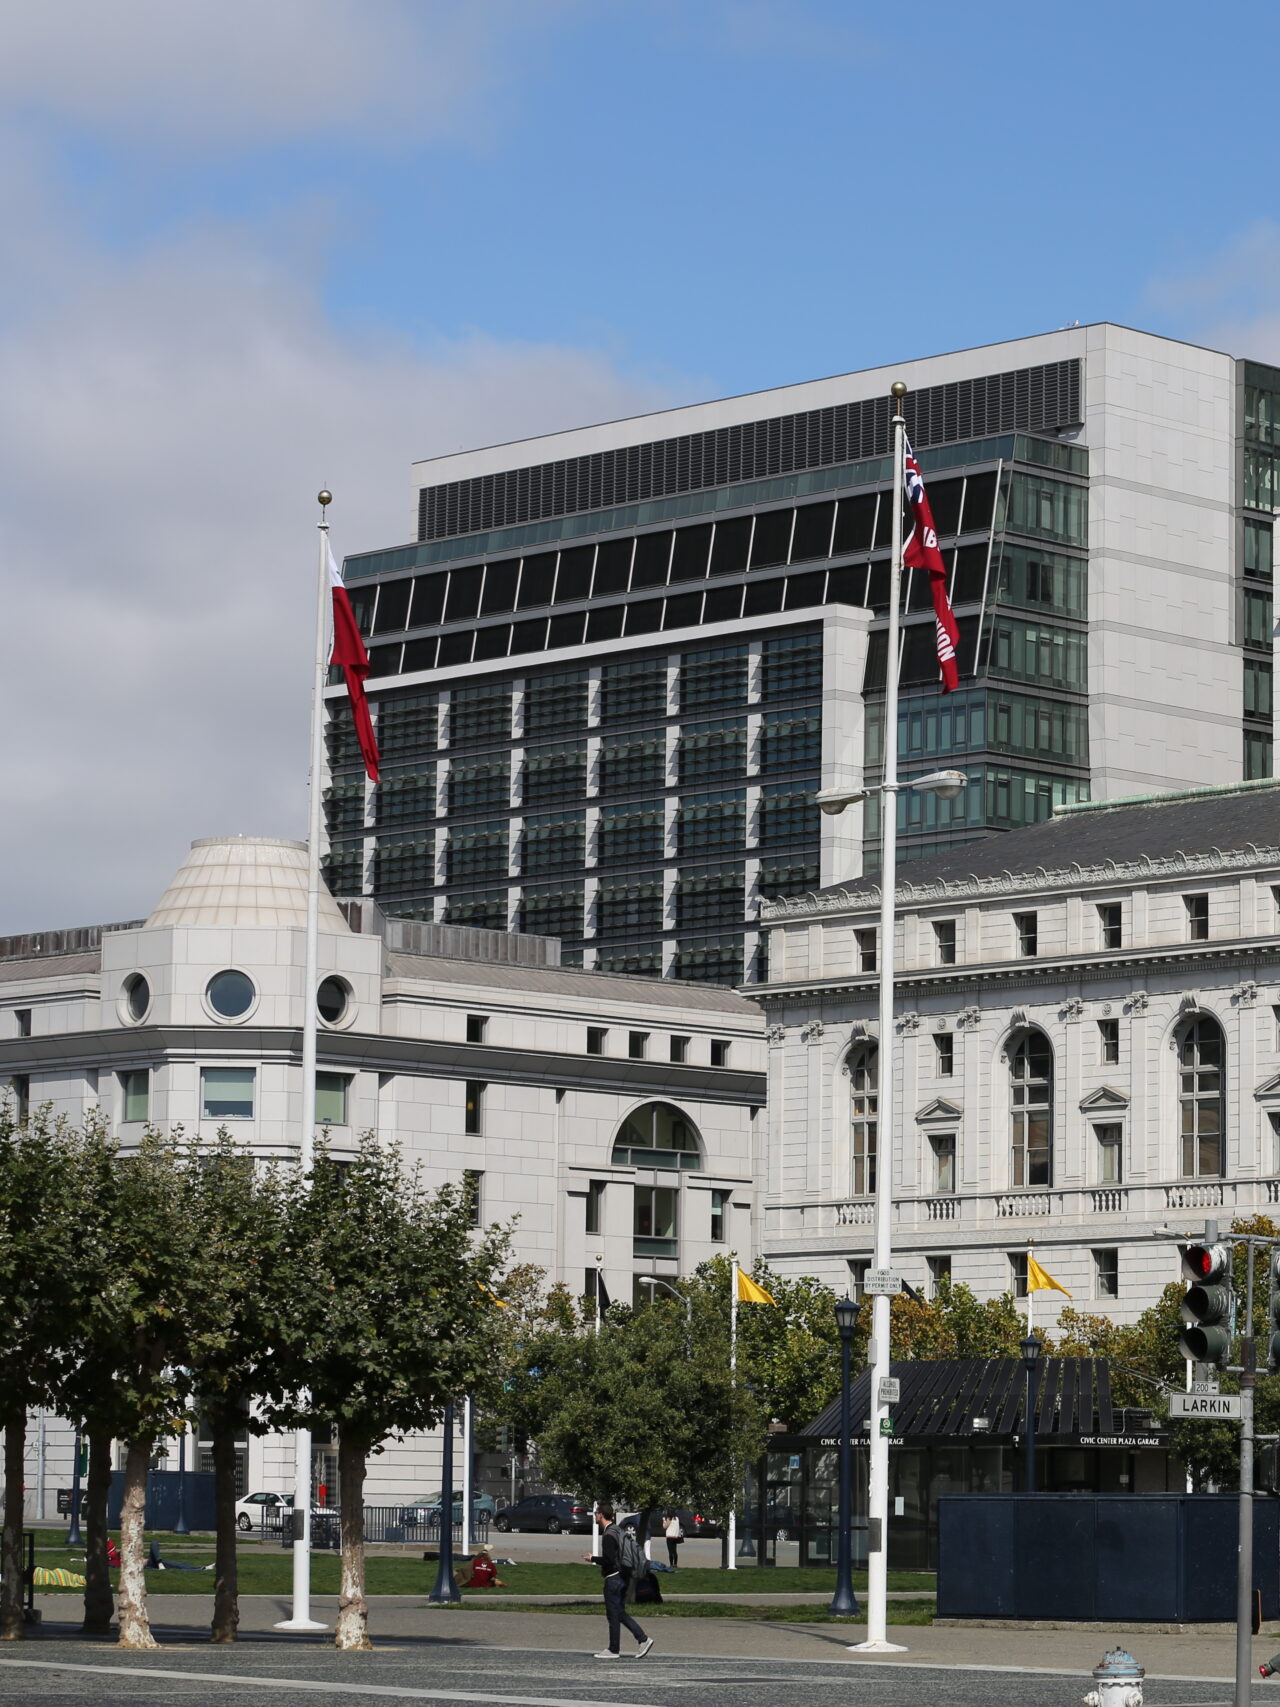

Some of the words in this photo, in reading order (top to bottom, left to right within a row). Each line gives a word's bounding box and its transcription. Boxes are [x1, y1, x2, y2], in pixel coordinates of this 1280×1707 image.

[1196, 1384, 1209, 1392] 200
[1183, 1399, 1230, 1413] LARKIN
[1097, 1437, 1117, 1445] CENTER
[1137, 1438, 1160, 1446] GARAGE
